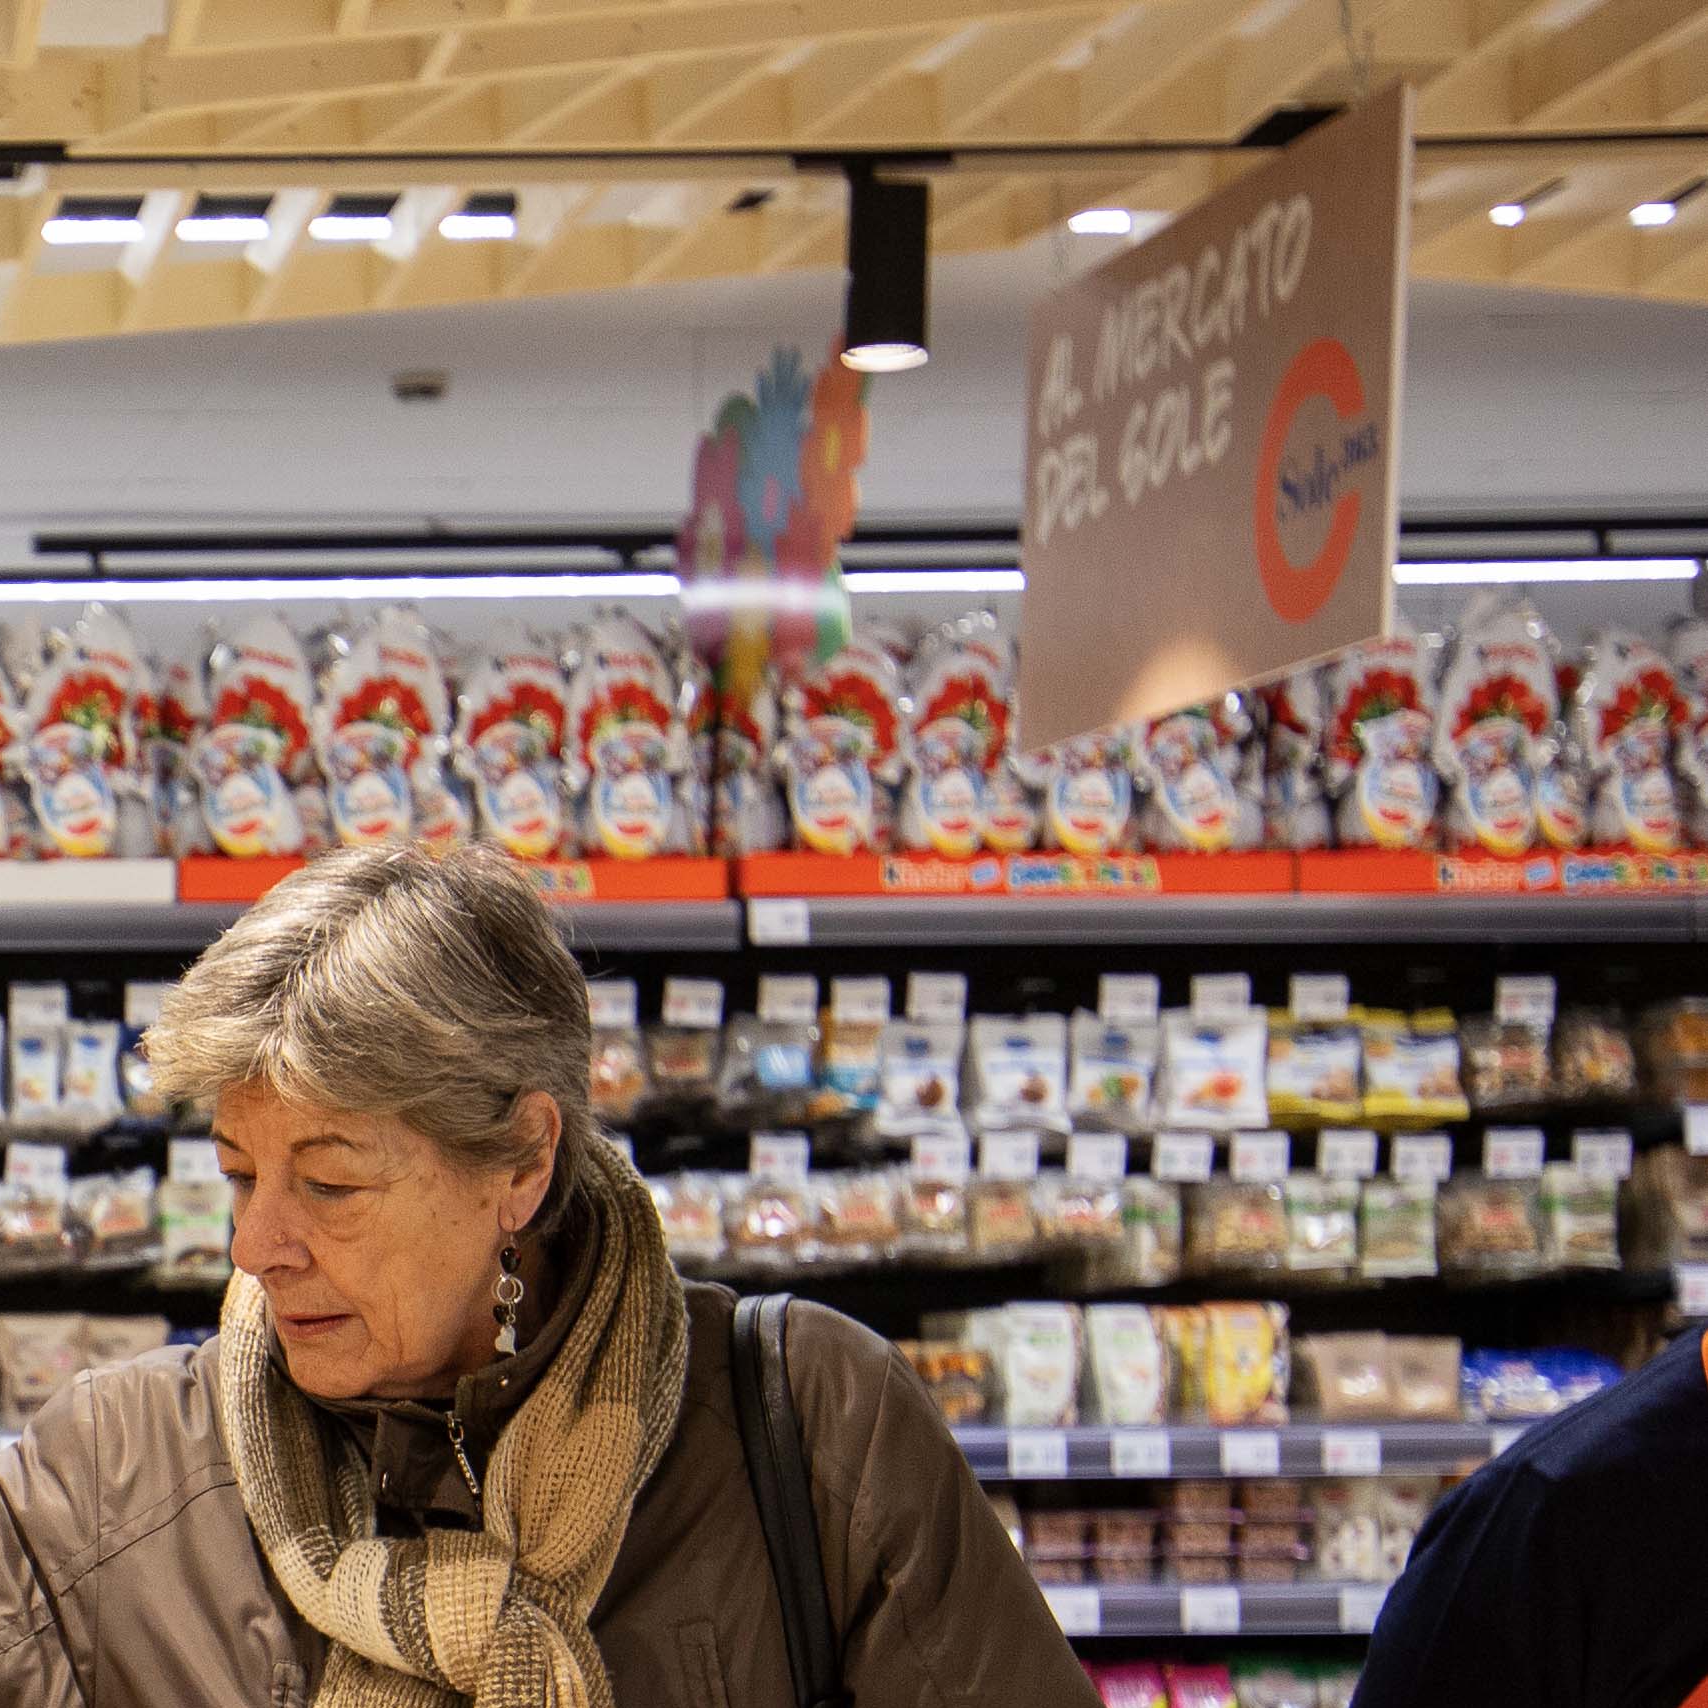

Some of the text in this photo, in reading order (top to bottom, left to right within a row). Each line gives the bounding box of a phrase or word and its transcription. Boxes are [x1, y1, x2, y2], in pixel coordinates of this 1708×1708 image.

[1037, 192, 1313, 438] AL MERCATO
[1036, 356, 1236, 546] DEL SOLE
